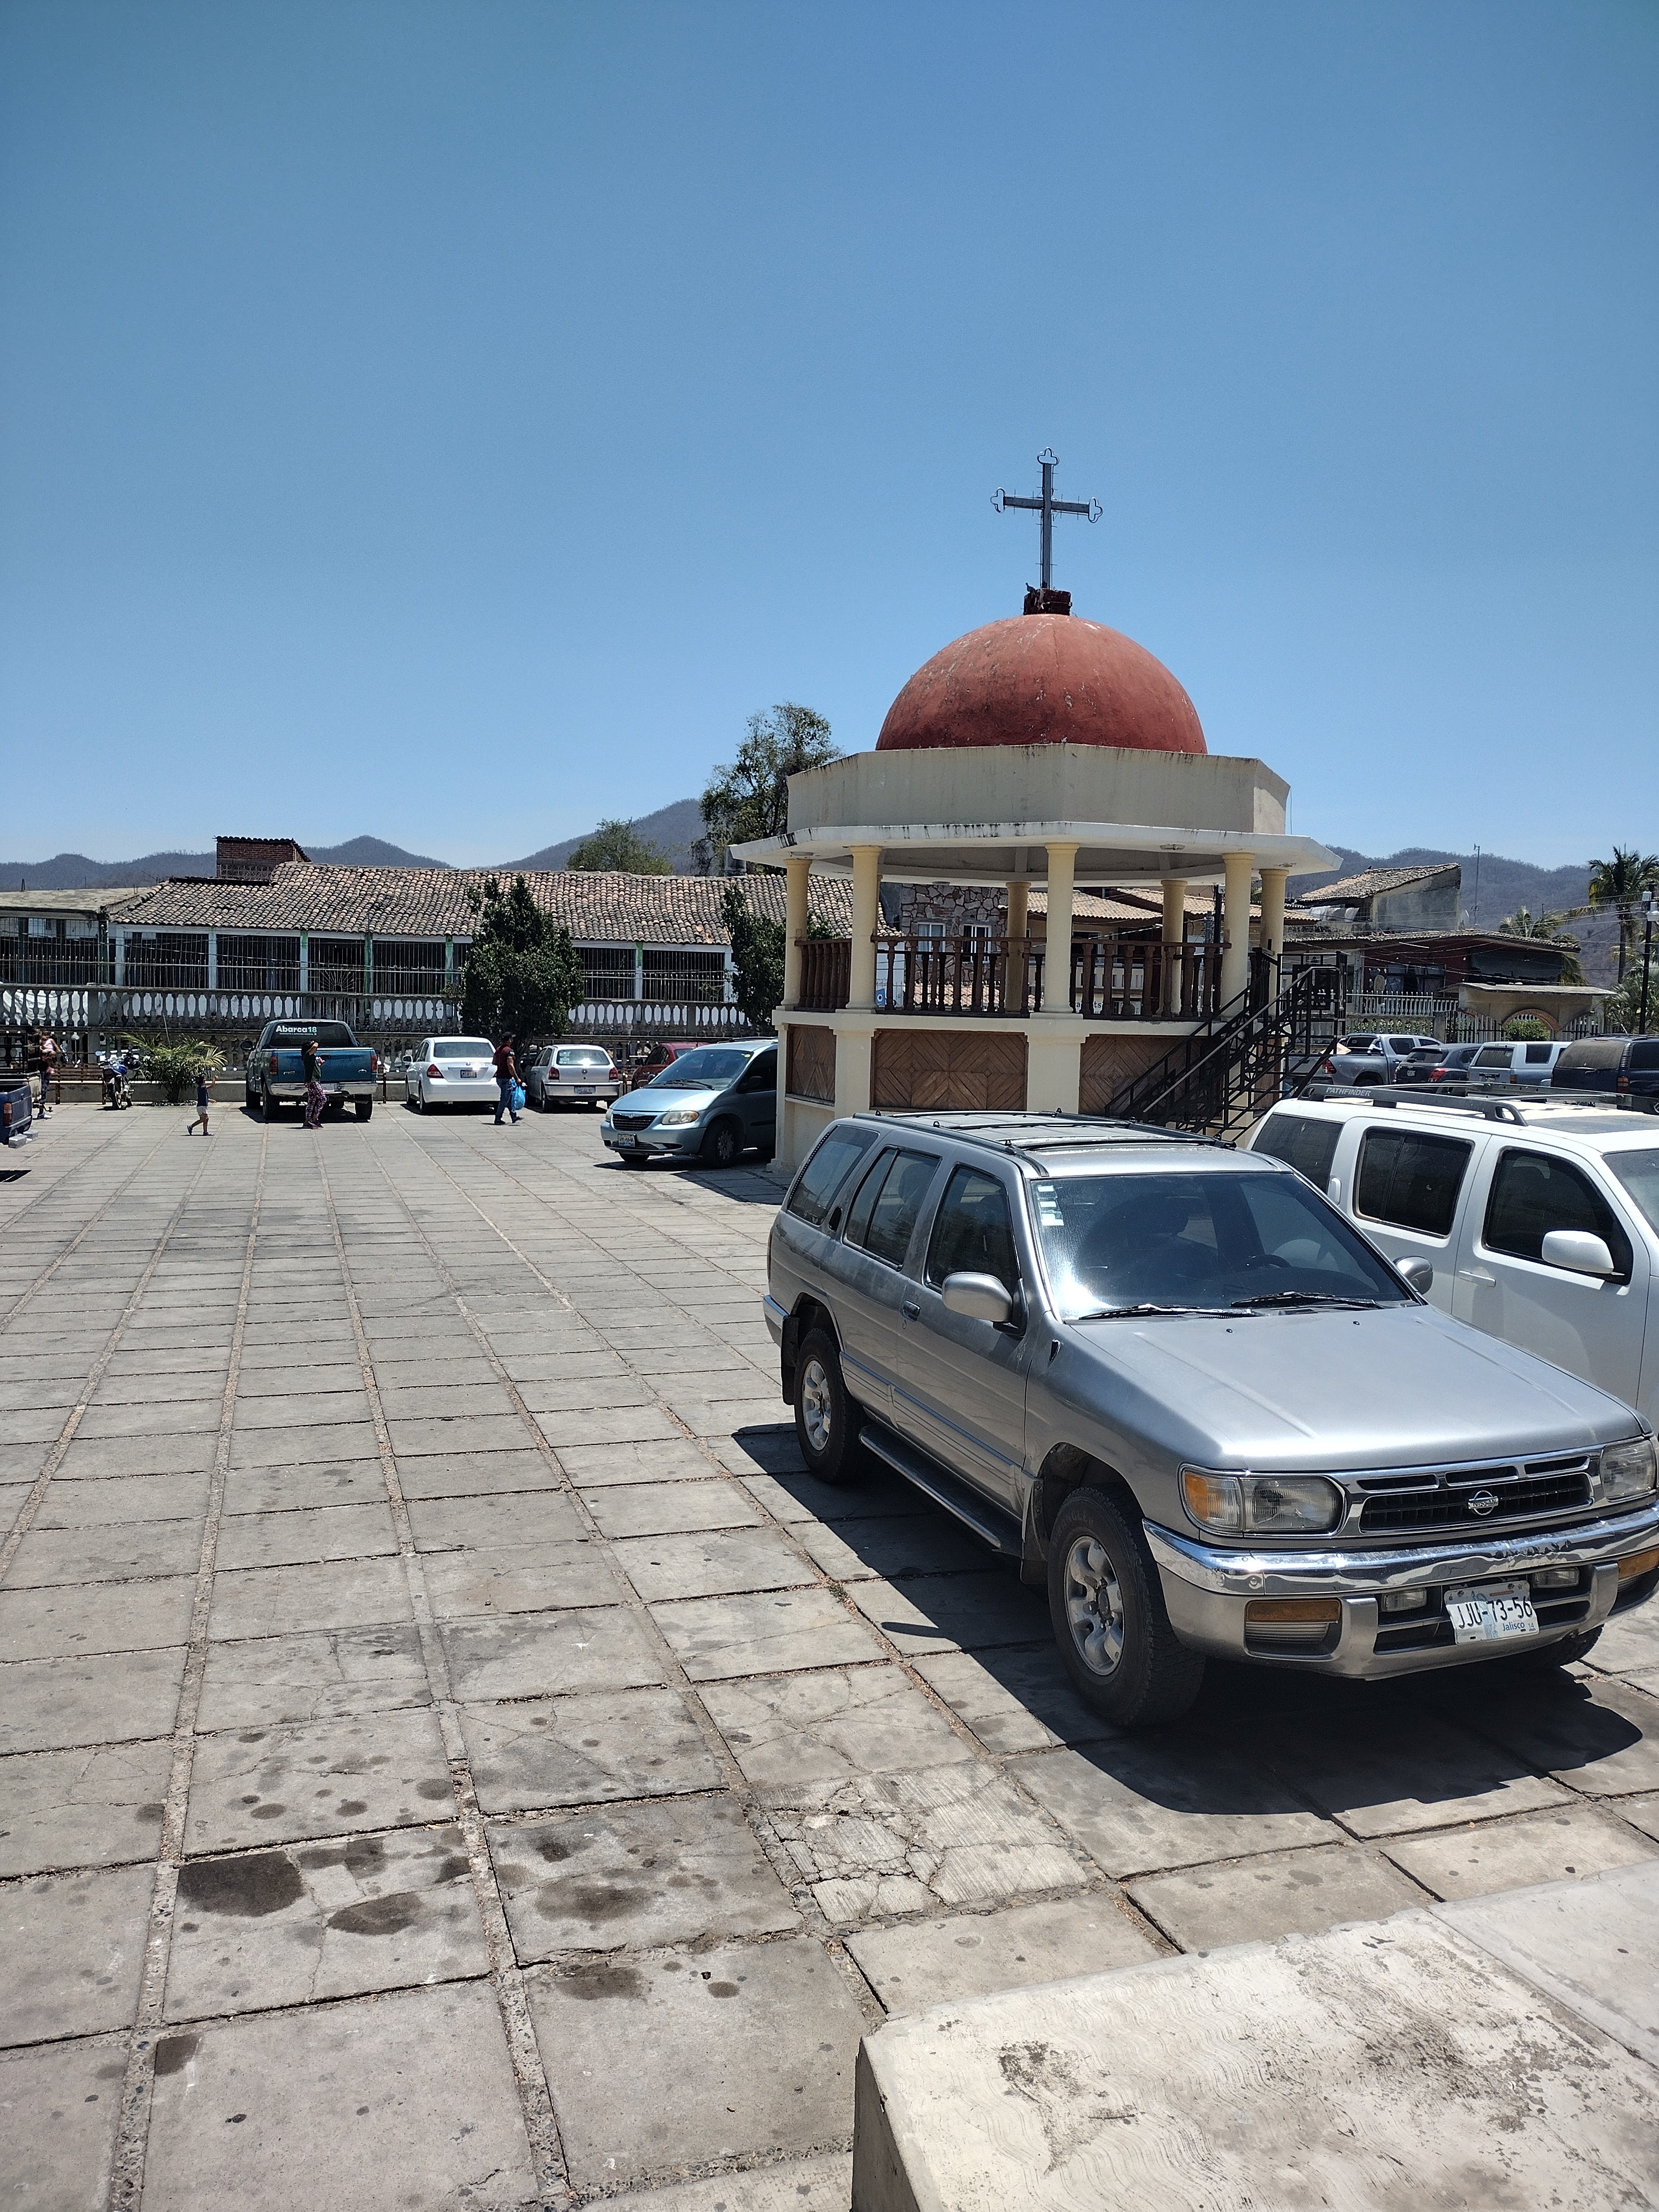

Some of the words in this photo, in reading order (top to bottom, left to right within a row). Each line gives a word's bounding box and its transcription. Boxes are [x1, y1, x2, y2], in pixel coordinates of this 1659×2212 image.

[1326, 1087, 1371, 1097] PATHFINDER
[1457, 1596, 1533, 1629] JJU-73-56
[1503, 1621, 1525, 1631] Jalisco
